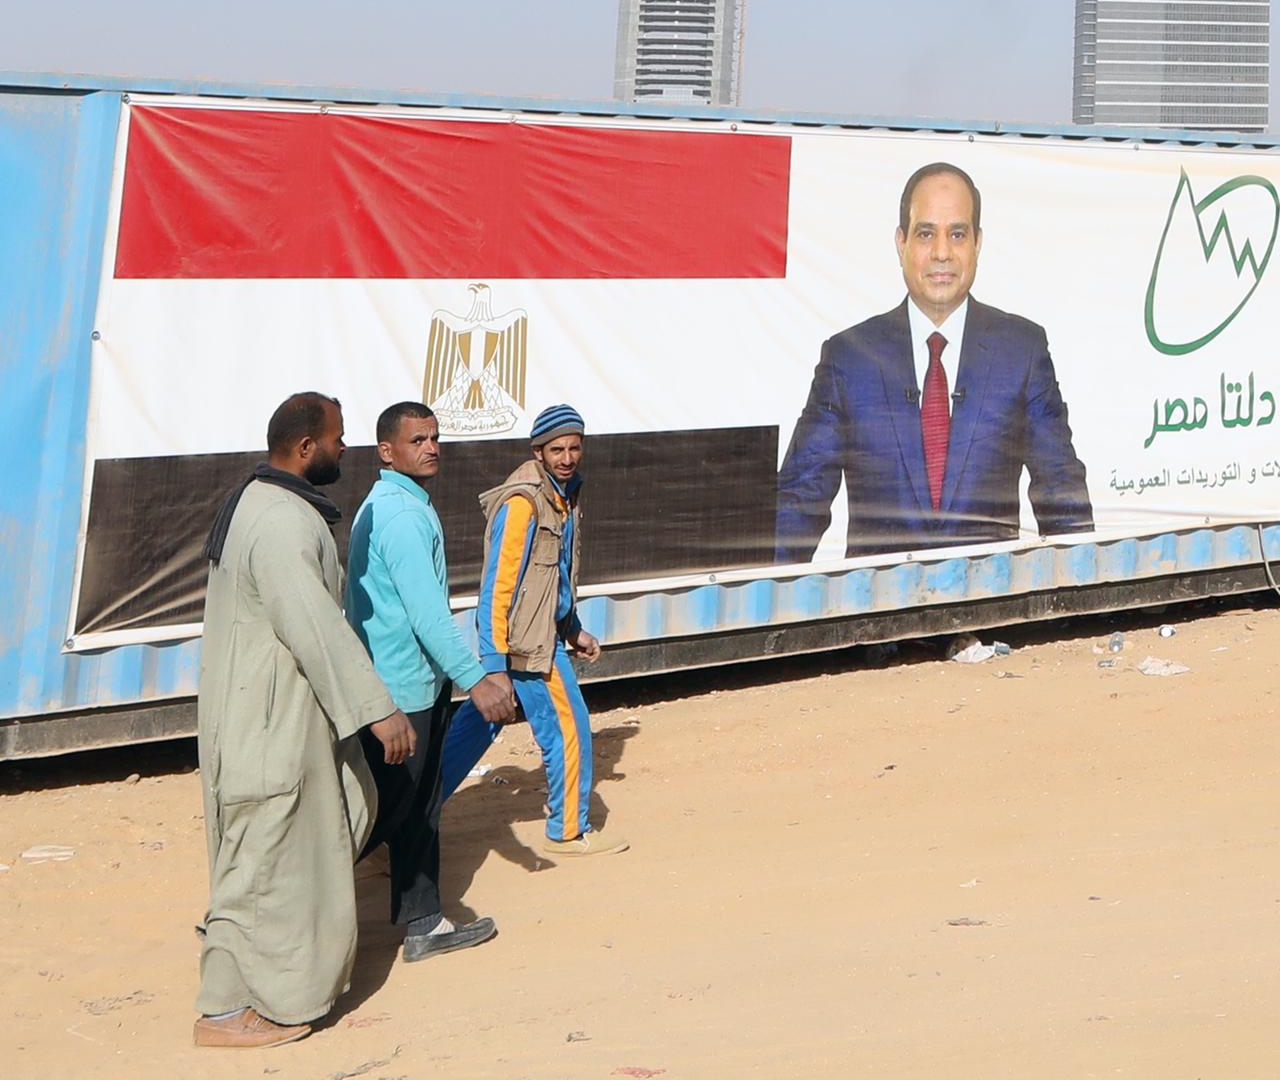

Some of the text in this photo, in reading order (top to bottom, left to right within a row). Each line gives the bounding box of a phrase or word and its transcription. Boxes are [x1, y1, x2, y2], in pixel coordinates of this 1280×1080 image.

[1144, 371, 1276, 449] دلتا مصر
[1110, 468, 1170, 496] العمومية
[1177, 461, 1241, 488] التوريدات
[1247, 467, 1256, 484] و
